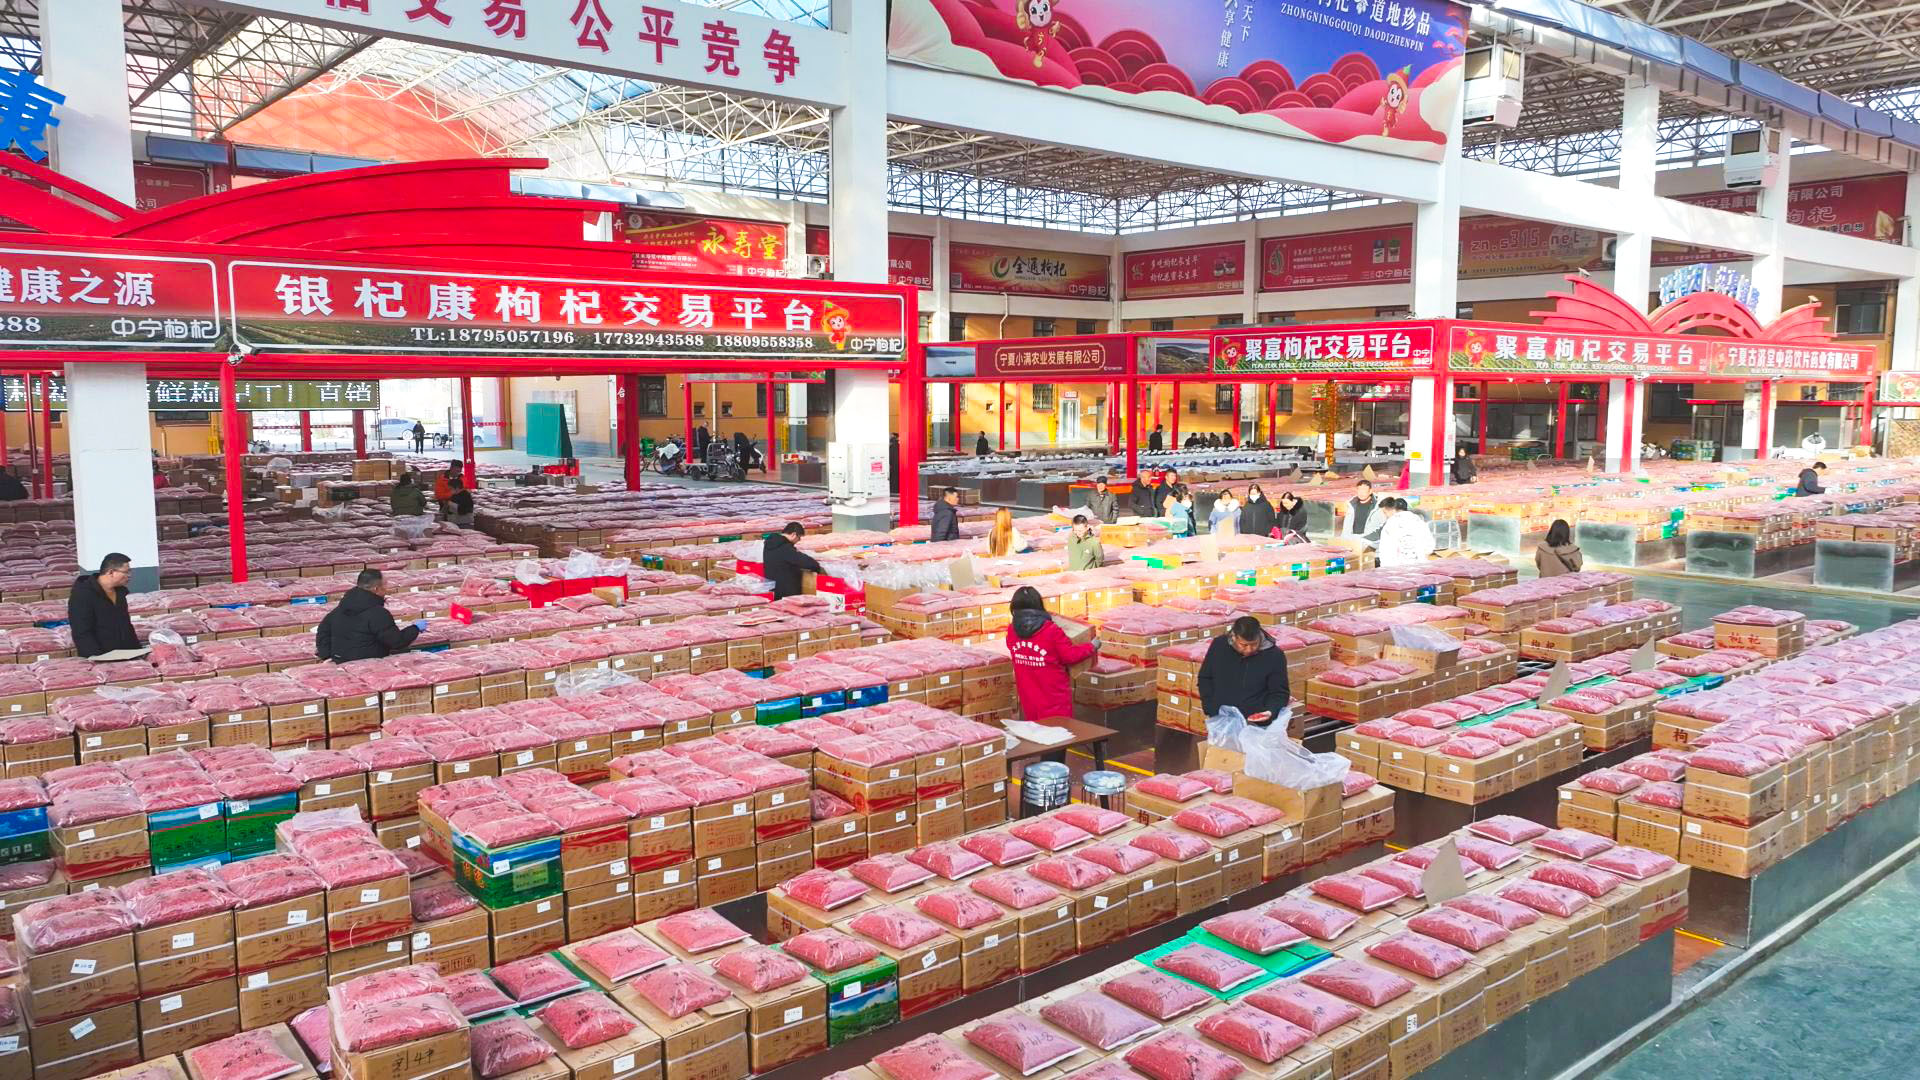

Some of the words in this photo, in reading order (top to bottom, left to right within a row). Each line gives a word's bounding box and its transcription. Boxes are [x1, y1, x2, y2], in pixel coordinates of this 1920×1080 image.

[1280, 2, 1362, 36] ZHONGNINGGOUQI
[1364, 26, 1424, 52] DAODIZHENPIN
[1369, 0, 1431, 36] 道地珍品
[274, 273, 814, 332] 银杞康枸杞交易平台
[111, 317, 217, 339] 中宁枸杞
[410, 327, 575, 344] TL:18795057196
[593, 331, 704, 348] 17732943588
[715, 334, 813, 348] 18809558358
[850, 338, 902, 351] 中宁枸杞
[1245, 332, 1412, 363] 聚富枸杞交易平台
[1494, 334, 1694, 365] 聚富枸杞交易平台
